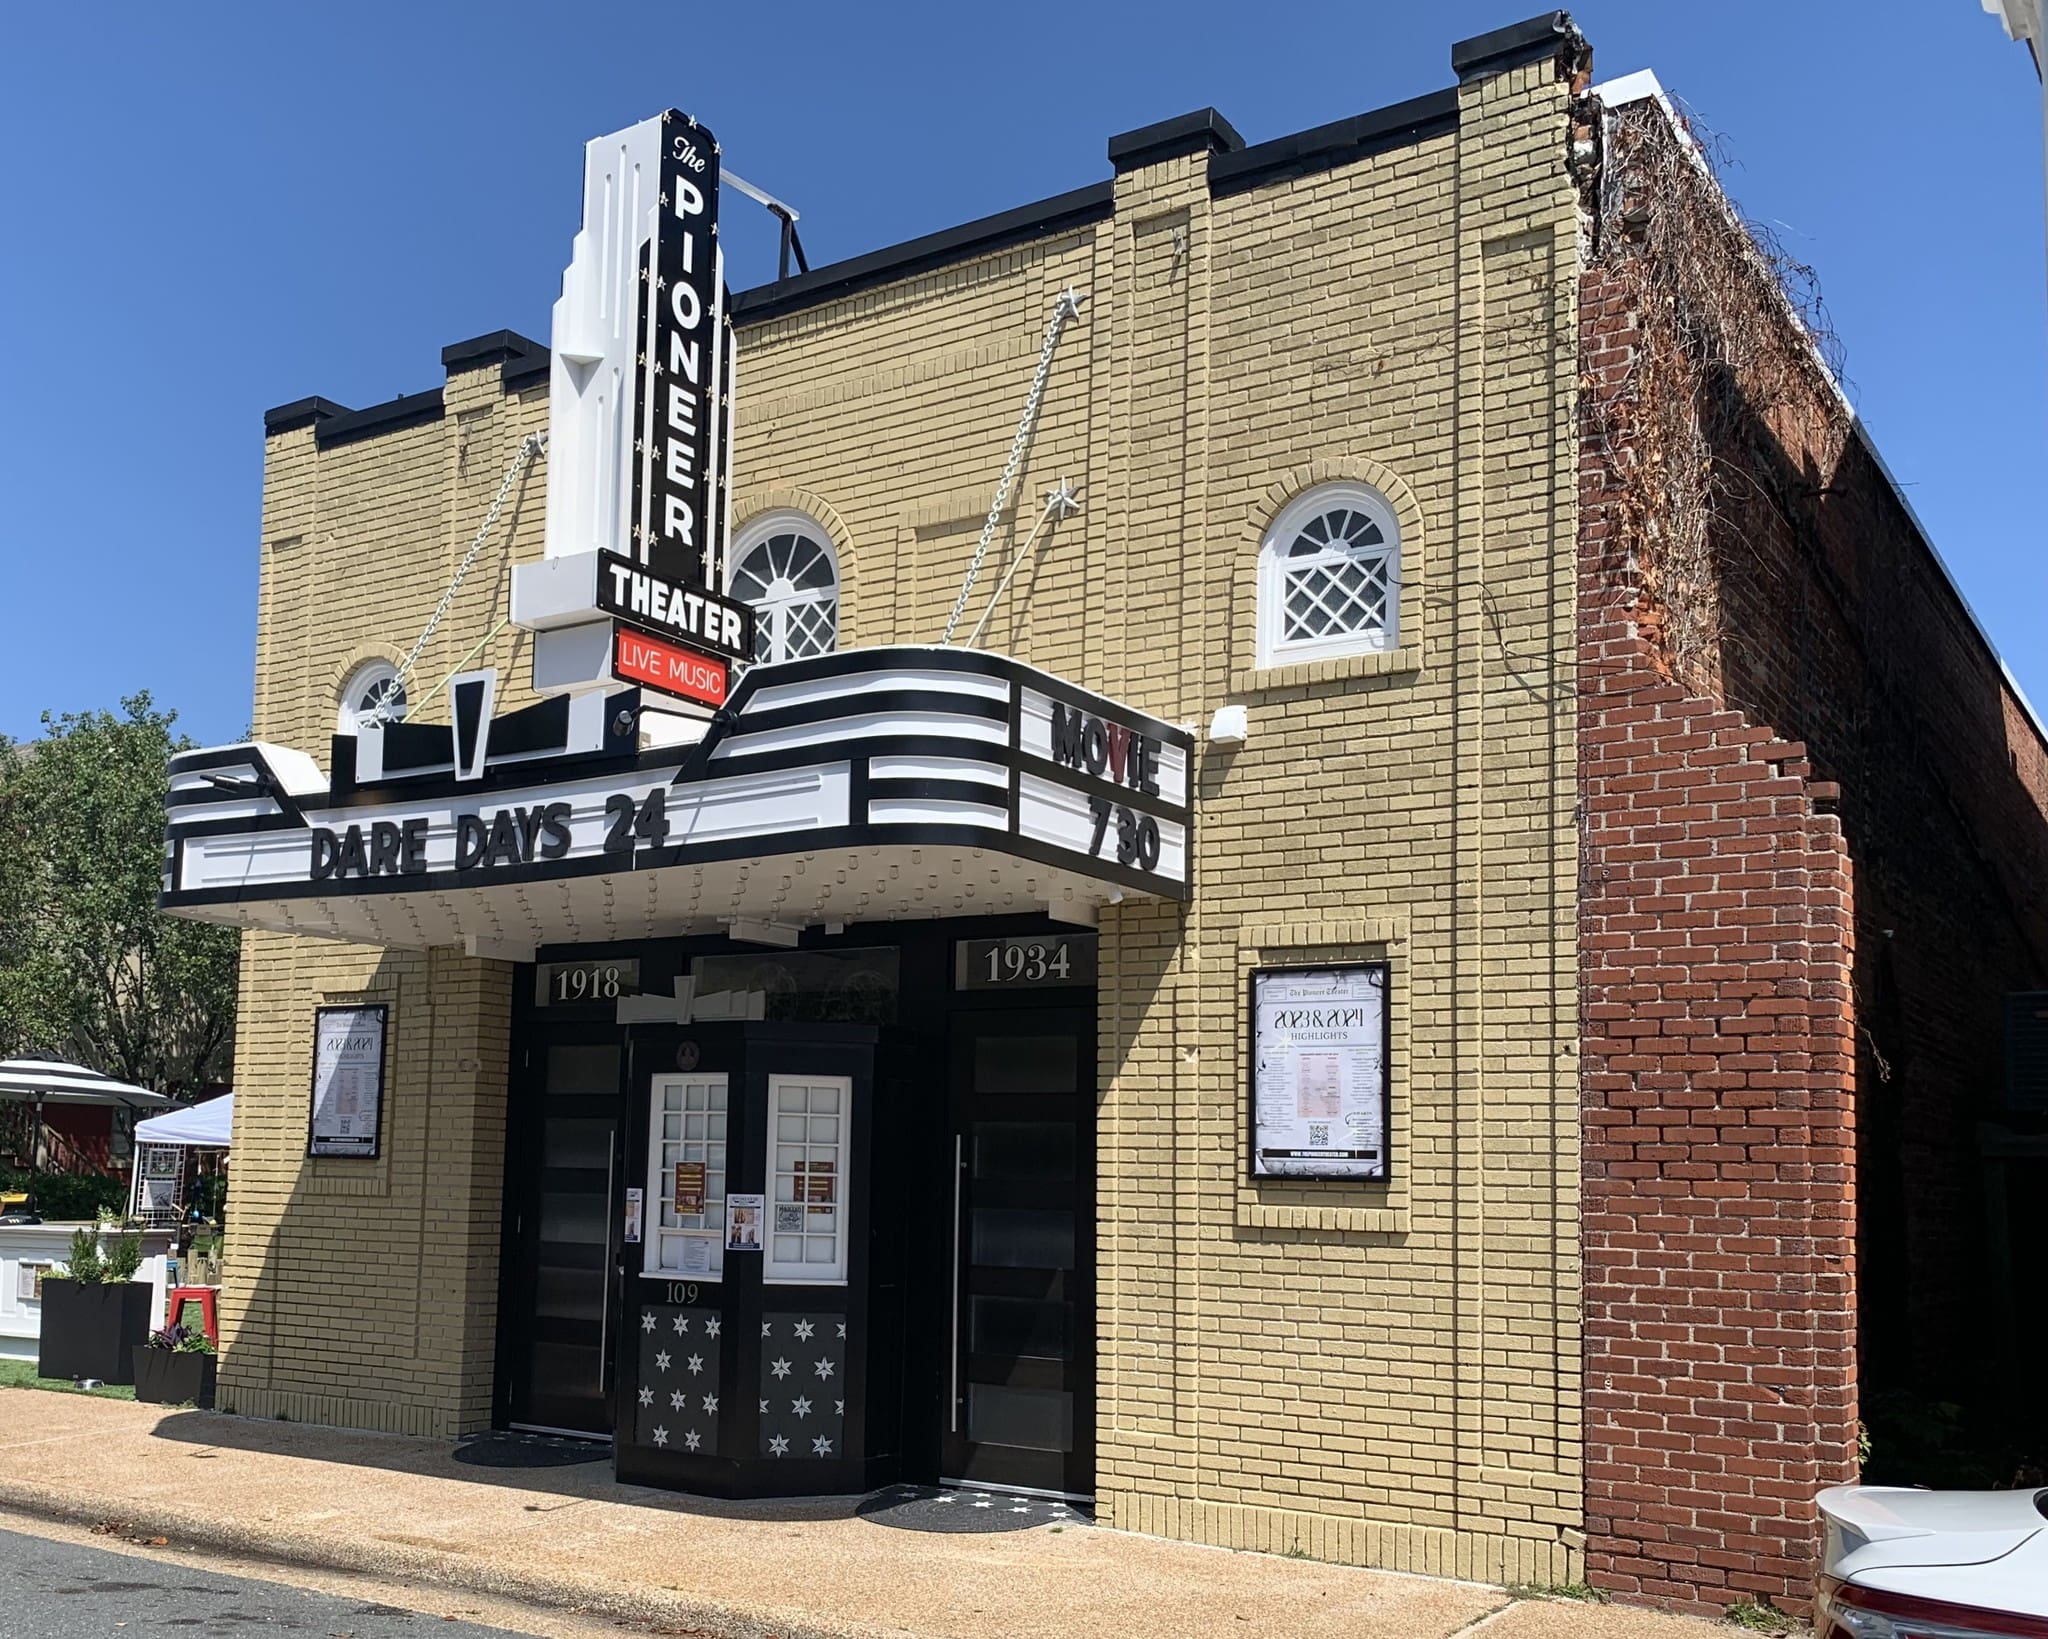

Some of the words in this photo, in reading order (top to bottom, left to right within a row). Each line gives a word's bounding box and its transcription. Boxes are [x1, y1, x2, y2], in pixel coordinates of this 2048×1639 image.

[672, 136, 705, 173] The
[665, 174, 705, 547] PIONEER
[609, 562, 742, 650] THEATER
[622, 641, 662, 676] LIVE
[669, 657, 721, 694] MUSIC
[1052, 701, 1162, 797] MOVIE
[310, 818, 429, 880] DARE
[454, 802, 572, 871] DAYS
[604, 787, 670, 852] 24
[984, 943, 1071, 982] 1934
[556, 967, 620, 1000] 1918
[1291, 1031, 1348, 1041] HIGHLIGHTS
[1312, 1008, 1324, 1028] &
[666, 1282, 699, 1305] 109
